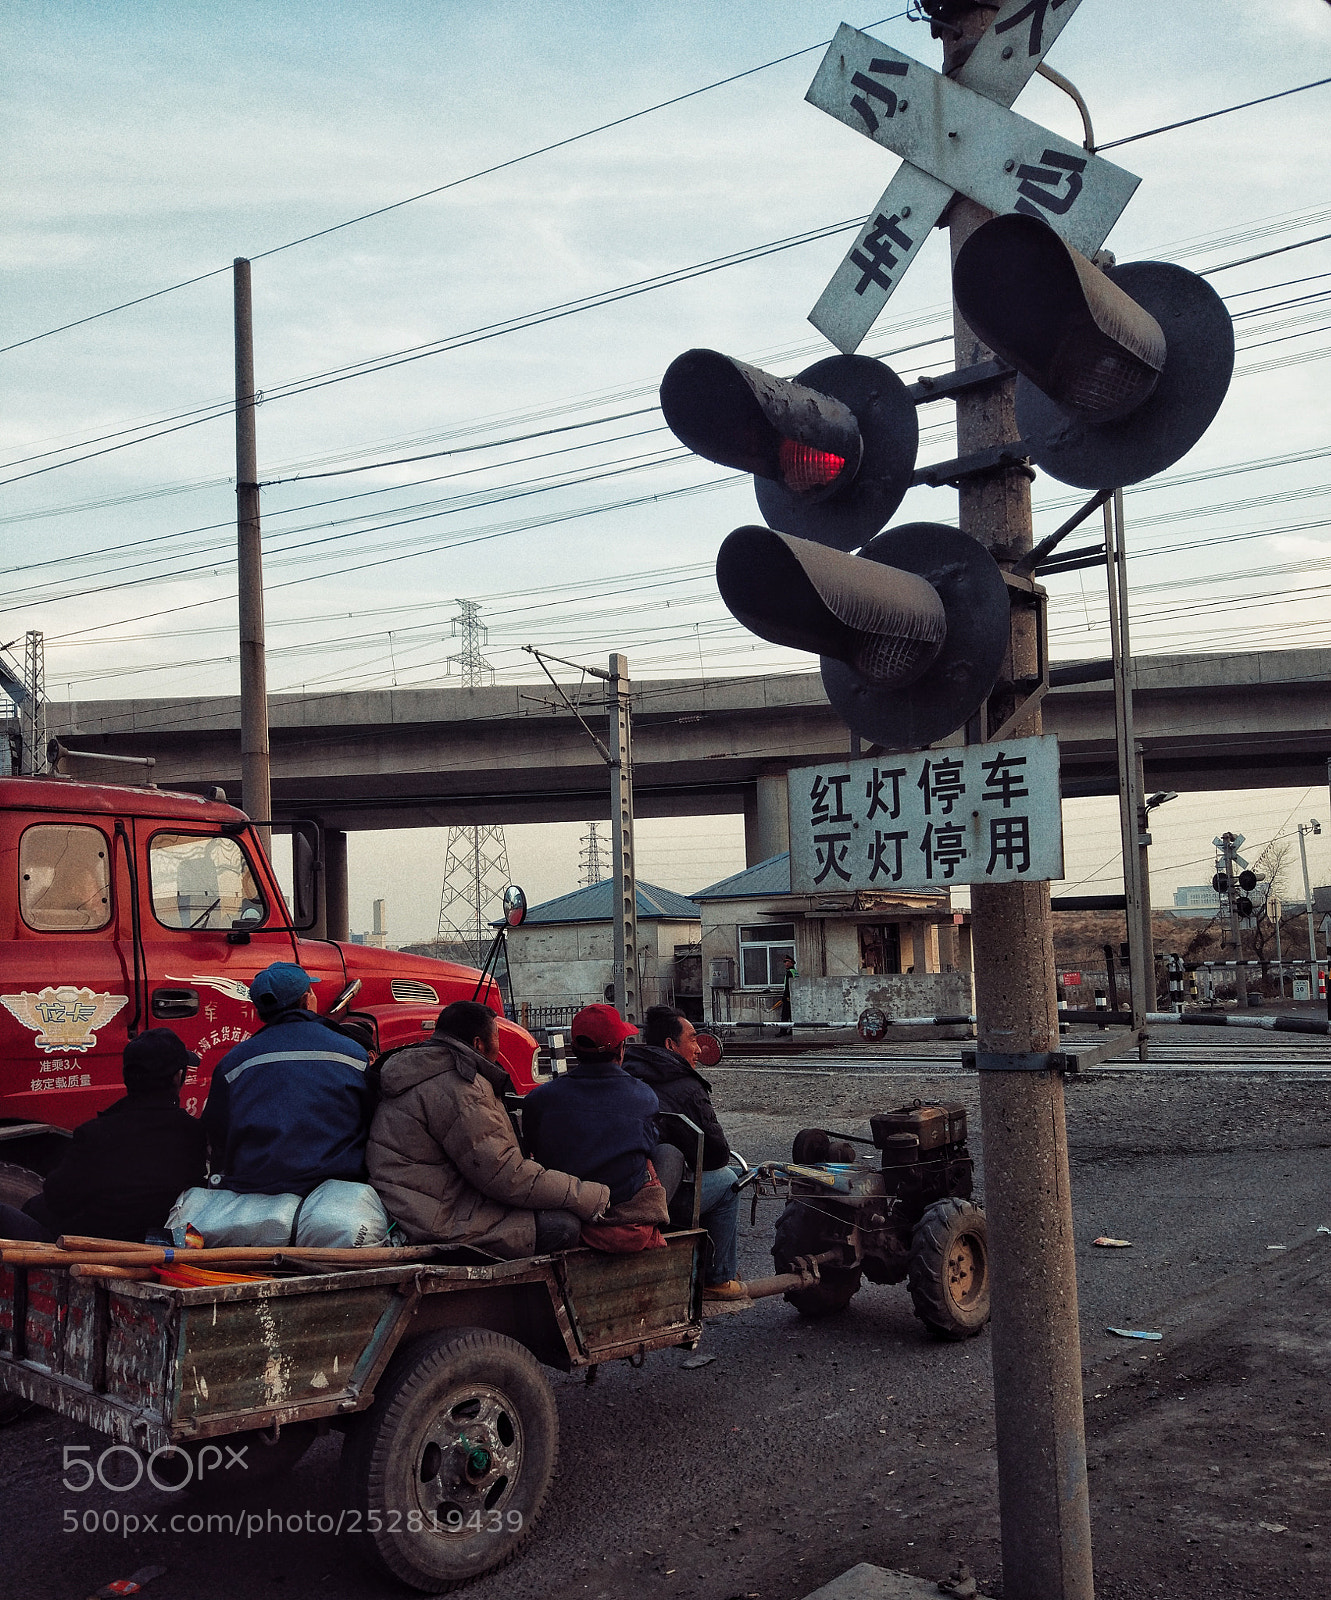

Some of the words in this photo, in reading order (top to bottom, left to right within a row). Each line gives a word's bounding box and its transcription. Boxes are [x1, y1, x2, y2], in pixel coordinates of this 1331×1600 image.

[810, 752, 1029, 826] 红灯停车
[813, 816, 1030, 885] 灭灯停用
[30, 1074, 91, 1091] 核定载质量
[40, 1058, 82, 1073] 准乘3人
